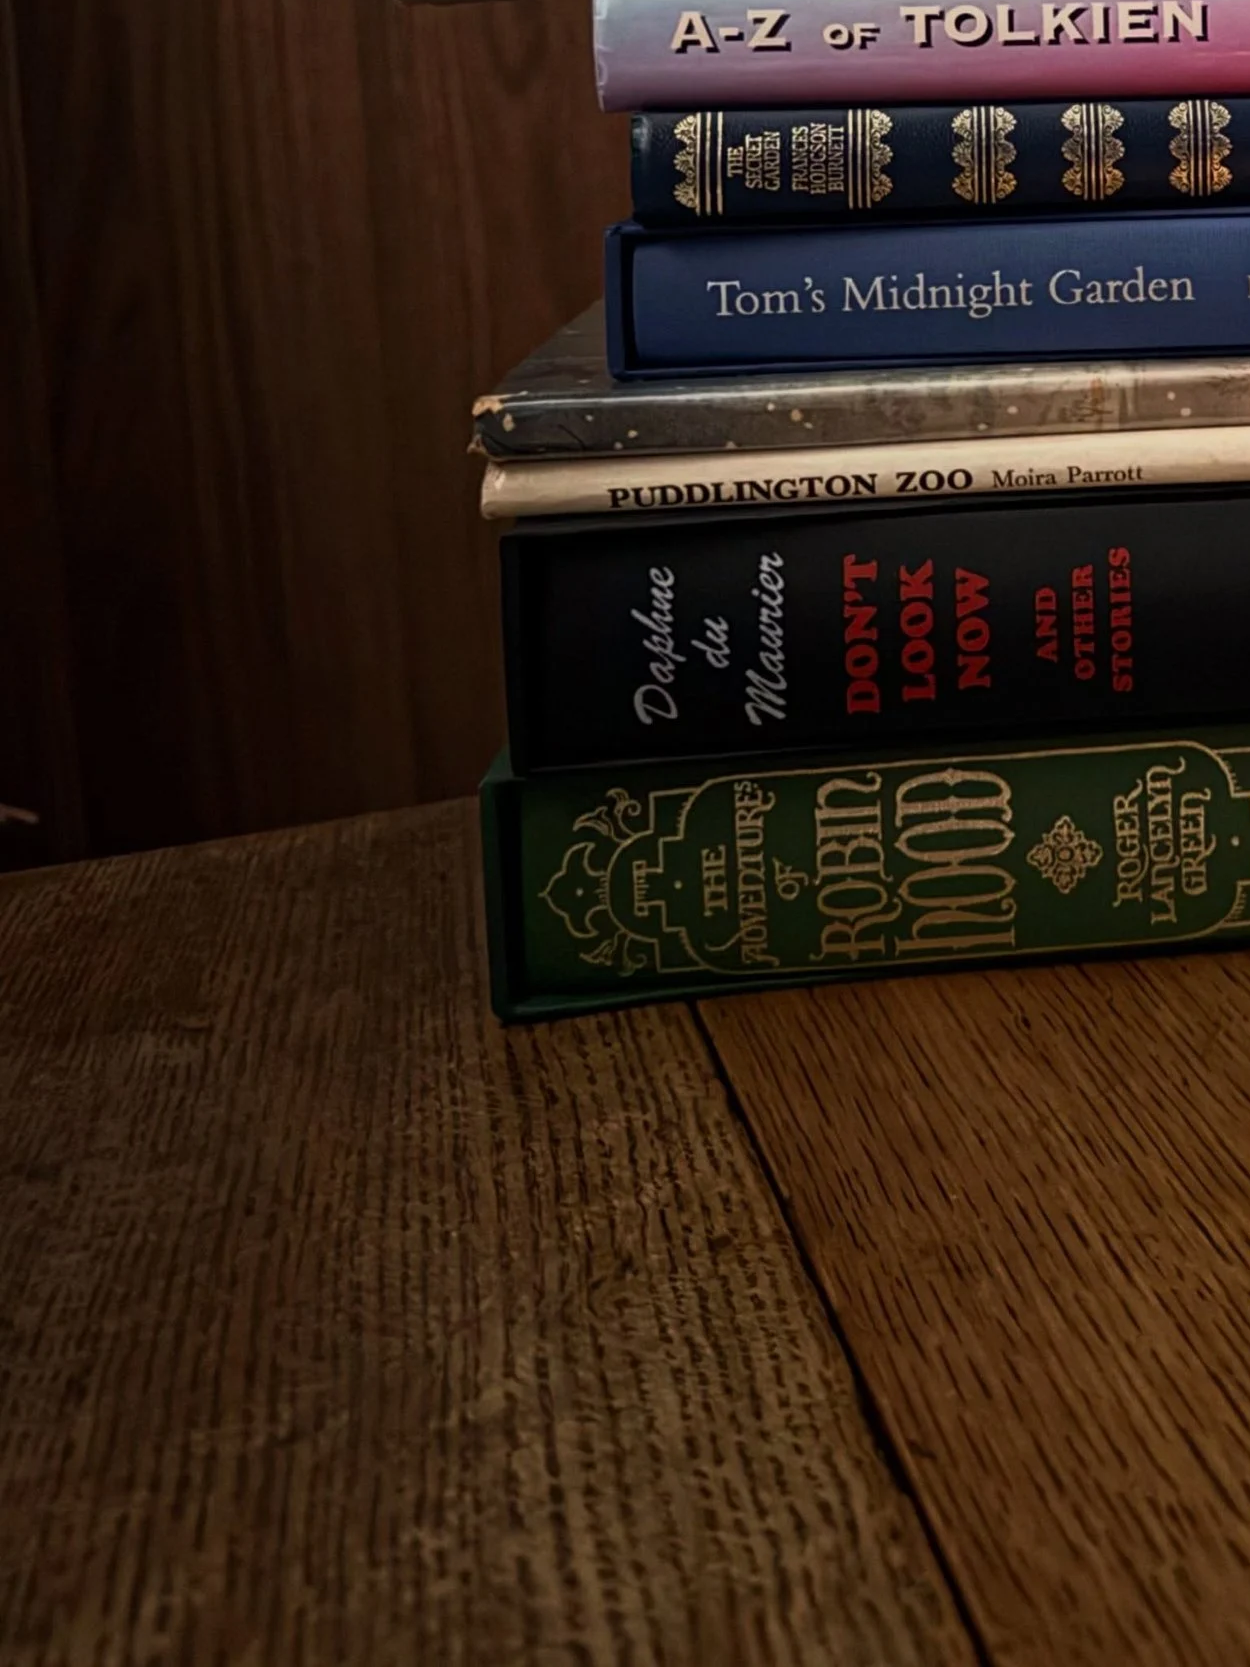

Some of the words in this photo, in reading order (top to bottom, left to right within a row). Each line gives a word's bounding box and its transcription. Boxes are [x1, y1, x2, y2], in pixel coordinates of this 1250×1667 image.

[668, 8, 793, 54] A-Z
[726, 145, 745, 178] THE
[744, 133, 764, 190] SECRET
[763, 130, 781, 192] GARDEN
[790, 124, 809, 193] FRANCES
[809, 121, 827, 195] HODGSON
[827, 124, 845, 192] BURNETT
[706, 275, 826, 319] Tom's
[841, 268, 1033, 321] Midnight
[1048, 264, 1196, 308] Garden
[606, 471, 879, 510] PUDDLINGTON
[893, 467, 975, 496] ZOO
[990, 465, 1058, 490] Moira
[1066, 462, 1145, 486] Parrott
[632, 564, 687, 726] Daphne
[691, 613, 732, 671] du
[743, 549, 787, 729] Maurier
[843, 552, 882, 716] DON'T
[899, 557, 937, 703] LOOK
[955, 565, 992, 691] NOW
[1034, 585, 1060, 664] AND
[1071, 563, 1096, 682] OTHER
[1107, 545, 1134, 693] STORIES
[701, 843, 730, 918] THE
[808, 770, 903, 962] ROBIN
[893, 767, 1017, 958] HOOD
[1113, 778, 1150, 909] ROGER
[1145, 755, 1187, 927] LANCELYN
[1179, 786, 1217, 897] GREEN
